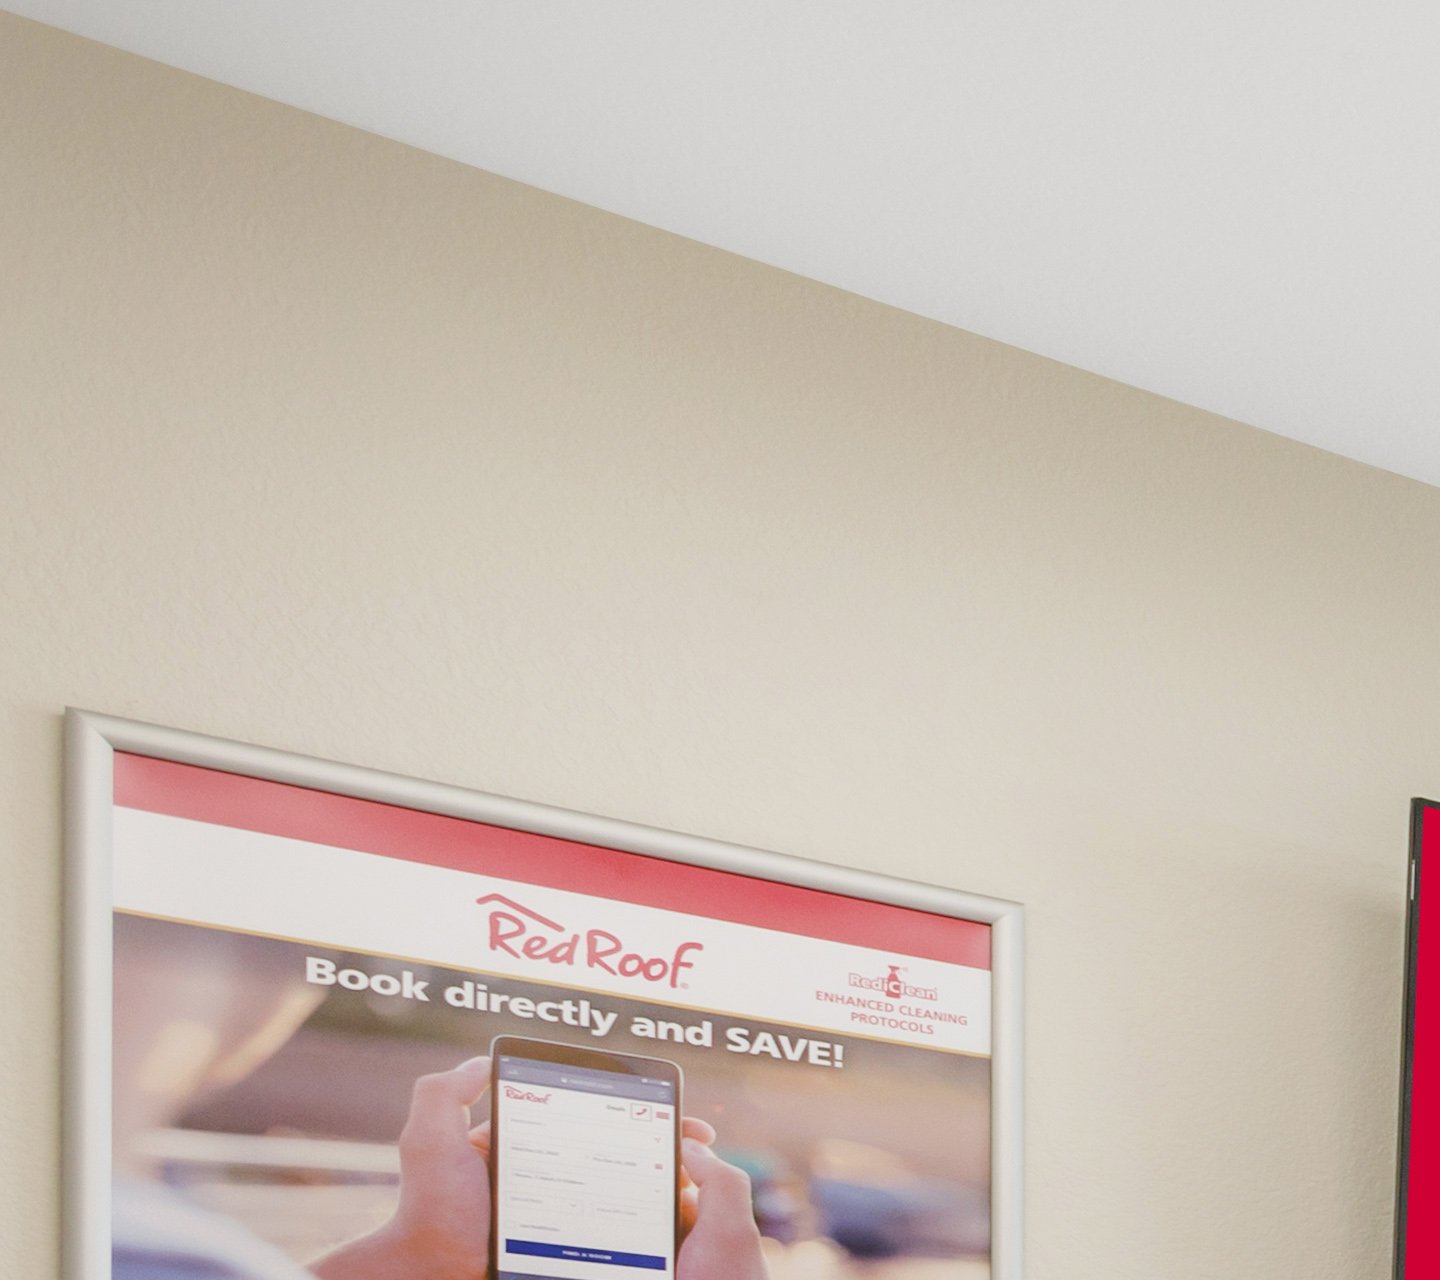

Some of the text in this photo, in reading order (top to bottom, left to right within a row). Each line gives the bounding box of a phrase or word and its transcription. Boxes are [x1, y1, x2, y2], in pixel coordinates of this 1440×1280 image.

[487, 910, 704, 988] Red Roof
[304, 956, 846, 1069] Book directly and SAVE!
[815, 990, 968, 1026] ENHANCED CLEANING
[850, 1012, 935, 1035] PROTOCOLS
